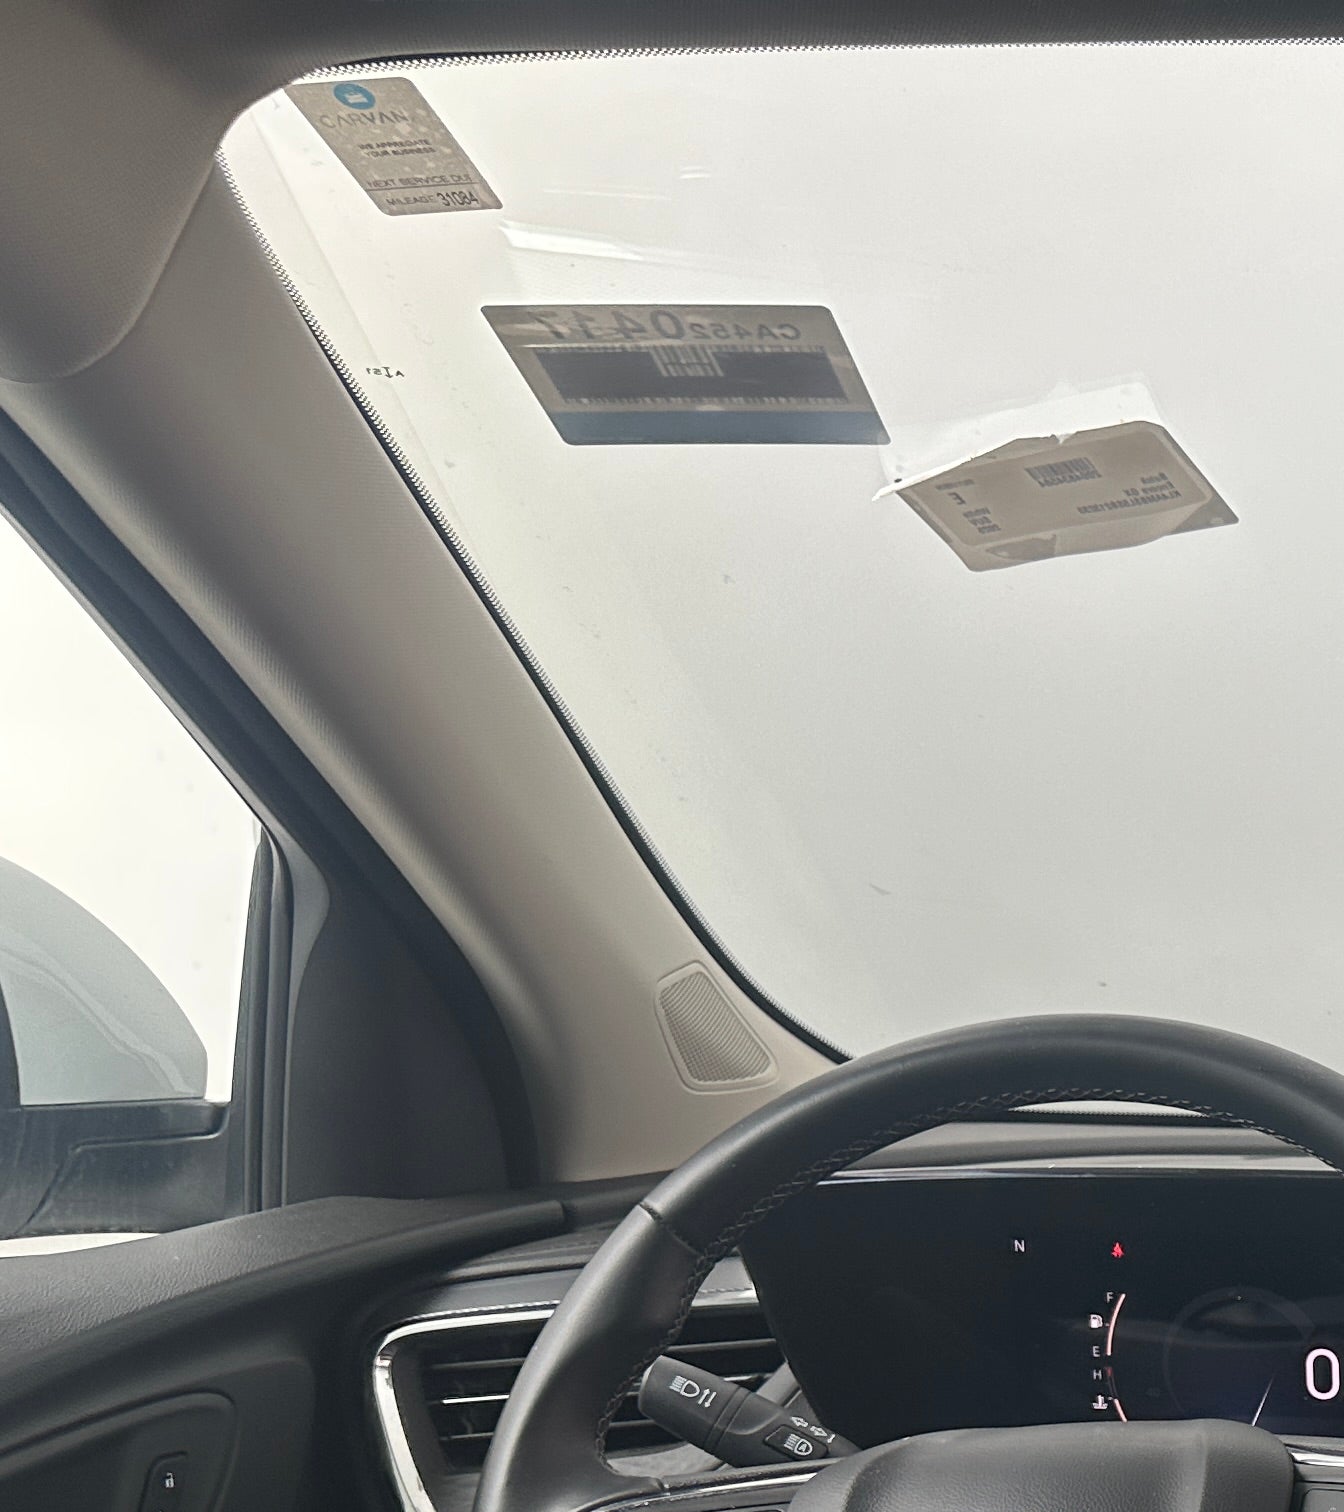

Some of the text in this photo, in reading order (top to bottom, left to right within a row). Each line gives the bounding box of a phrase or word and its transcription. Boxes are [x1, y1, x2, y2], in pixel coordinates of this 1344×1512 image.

[398, 175, 449, 186] SERVICE
[1014, 1240, 1026, 1252] N
[1106, 1292, 1114, 1302] F
[1092, 1346, 1100, 1357] E
[1093, 1370, 1101, 1380] H
[1304, 1347, 1341, 1401] 0
